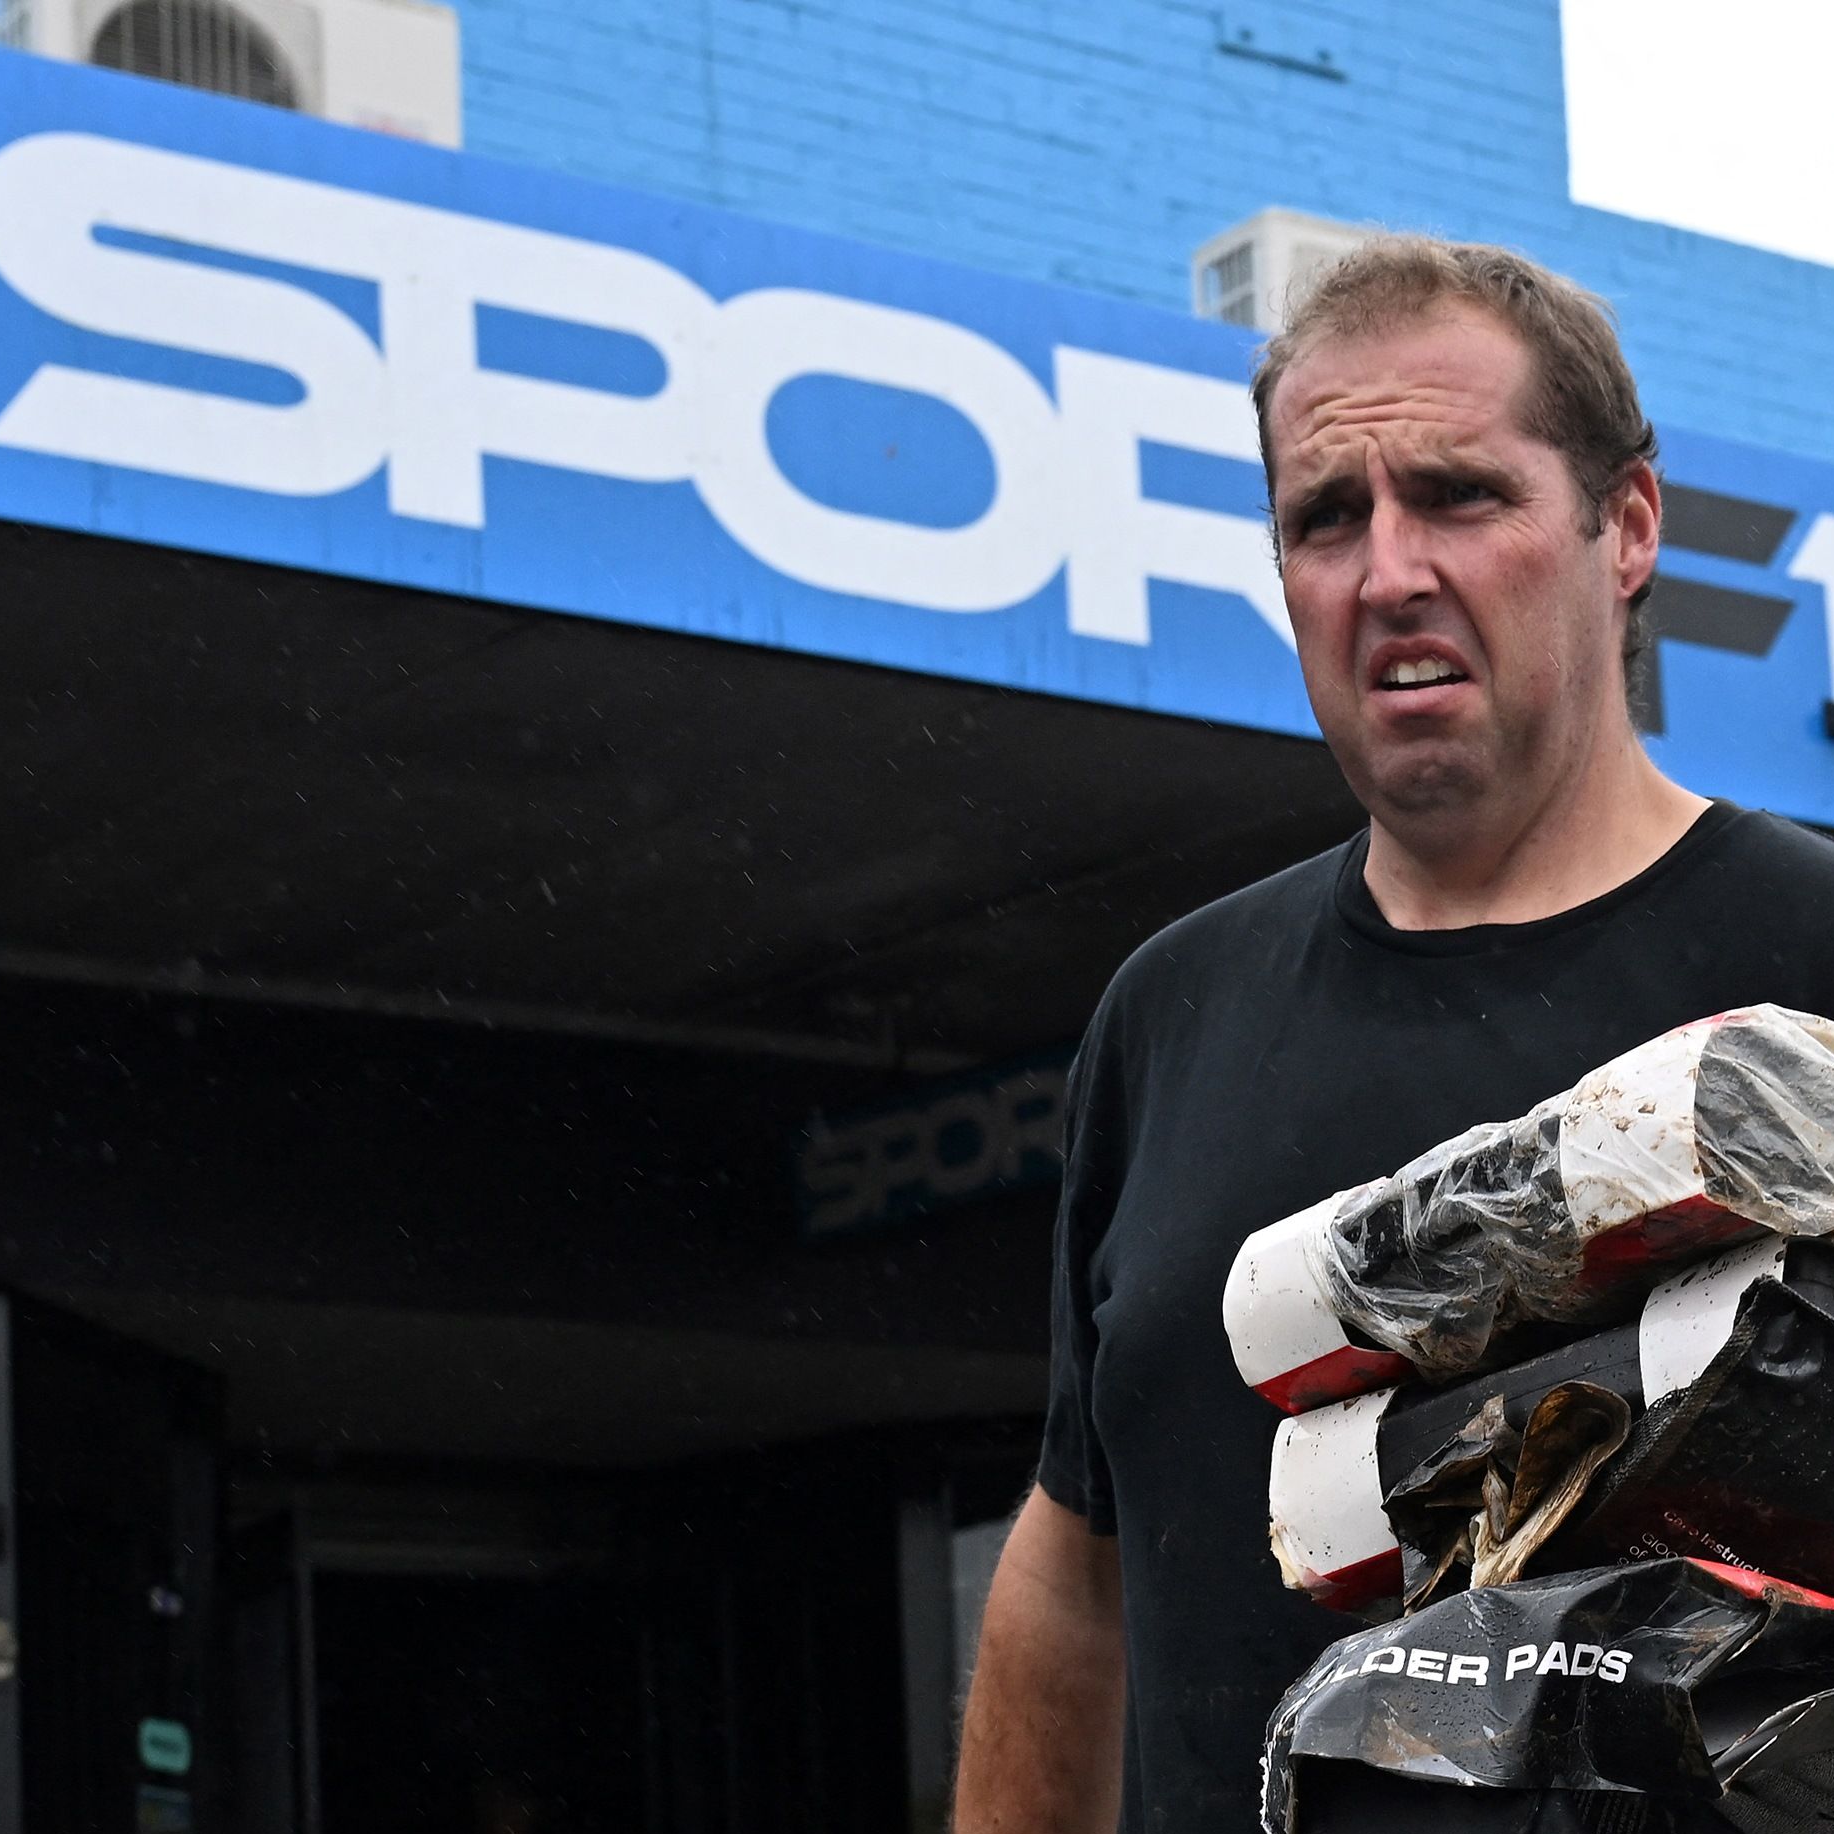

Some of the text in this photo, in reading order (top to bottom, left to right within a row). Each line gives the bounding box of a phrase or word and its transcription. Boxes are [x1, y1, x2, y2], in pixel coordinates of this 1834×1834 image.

[801, 1068, 1069, 1234] SPOR
[1700, 1532, 1767, 1575] Instruc
[1505, 1640, 1633, 1684] PADS
